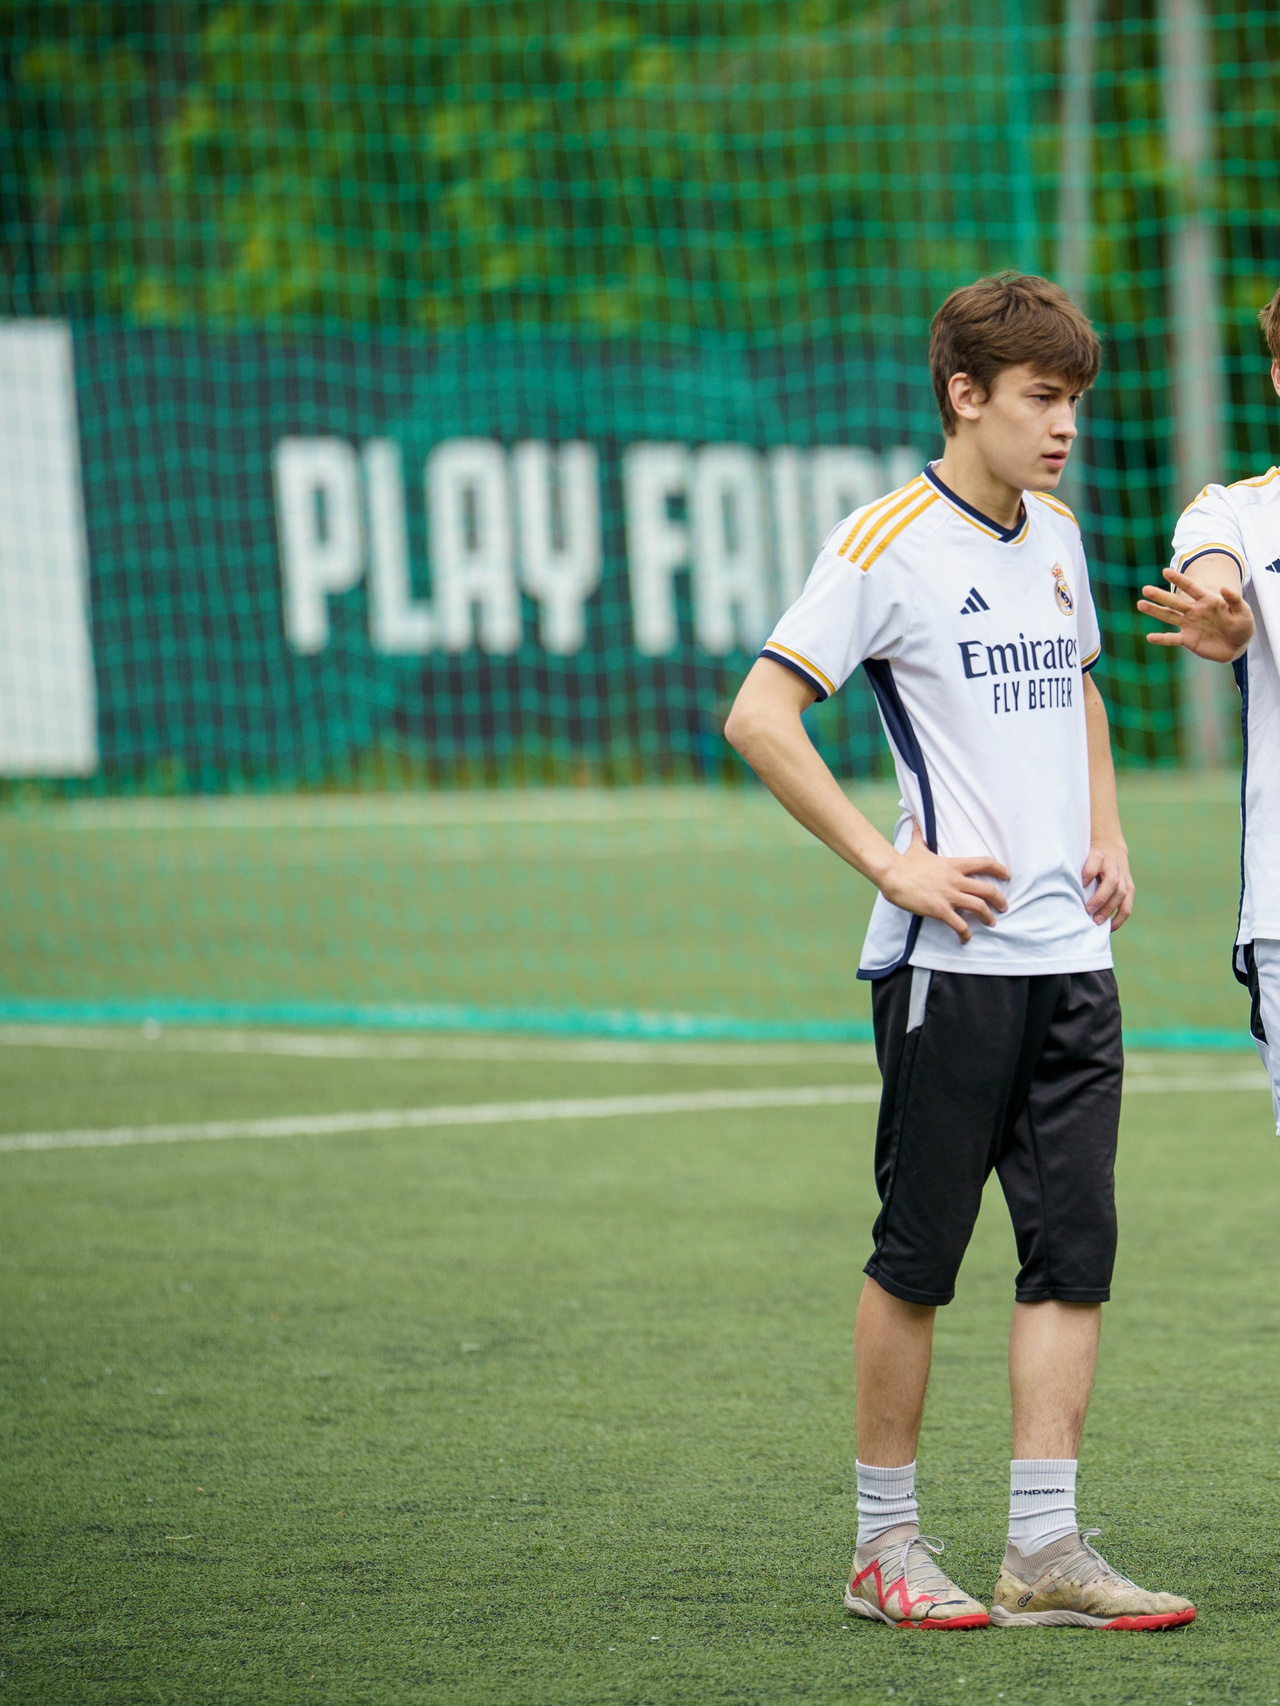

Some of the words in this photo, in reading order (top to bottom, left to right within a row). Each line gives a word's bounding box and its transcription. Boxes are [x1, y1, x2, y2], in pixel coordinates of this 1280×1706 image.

[274, 436, 602, 656] PLAY
[993, 680, 1020, 714] FLY
[1028, 677, 1073, 710] BETTER
